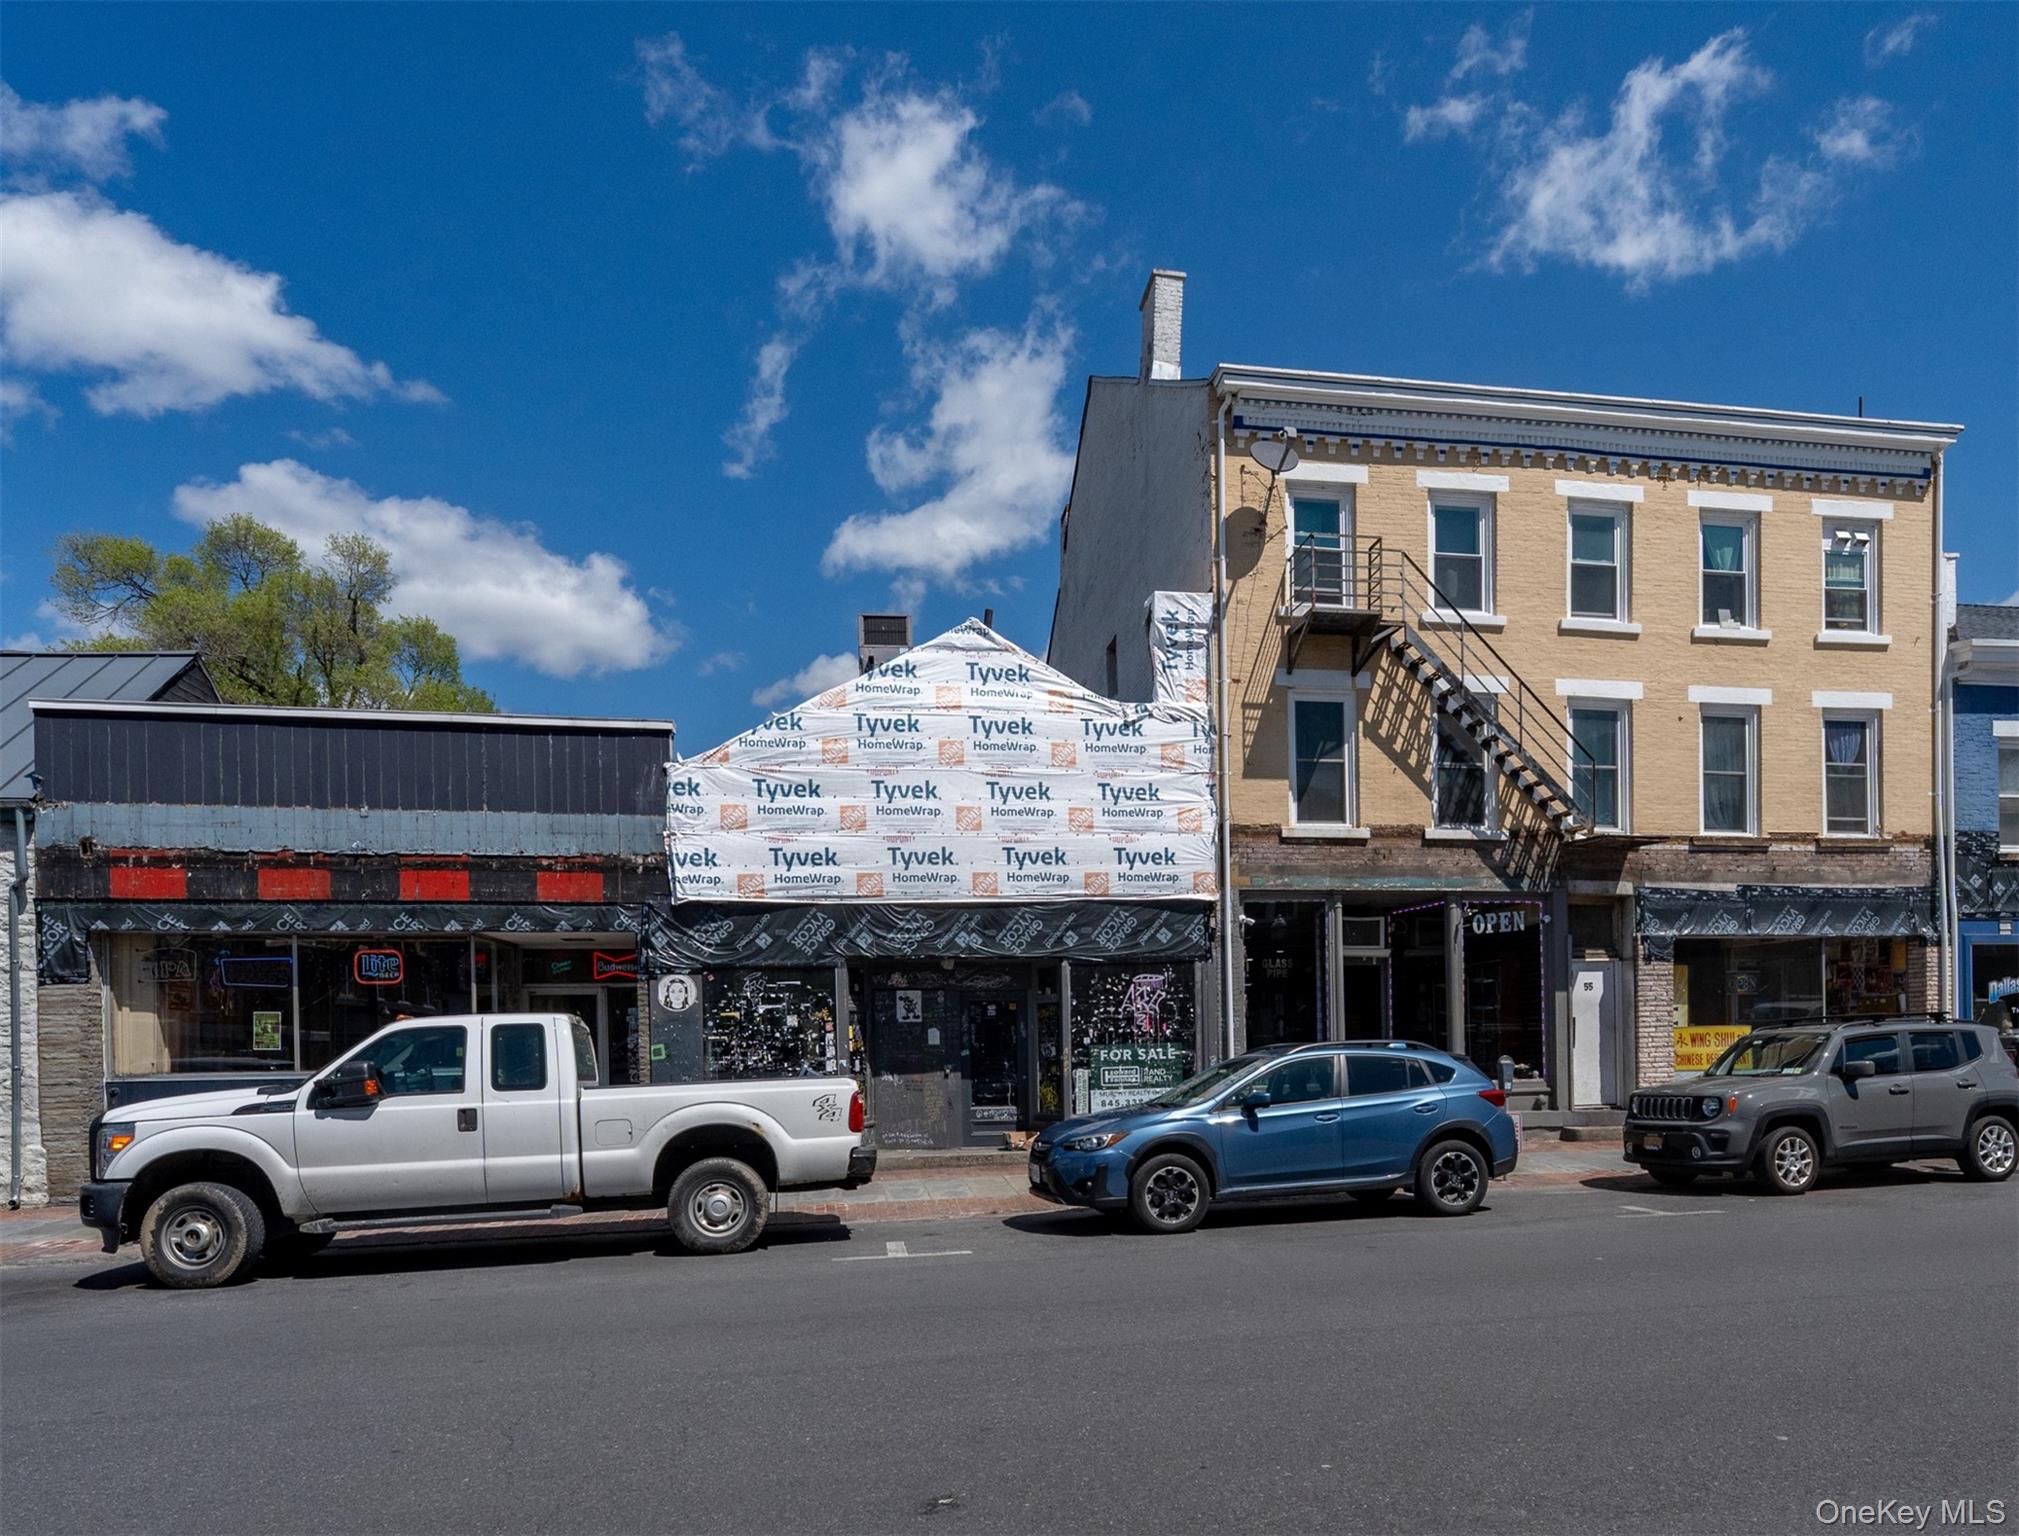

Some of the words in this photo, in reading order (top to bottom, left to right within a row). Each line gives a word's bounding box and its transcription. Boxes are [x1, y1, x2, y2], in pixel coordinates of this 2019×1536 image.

[1162, 609, 1183, 673] Tyvek
[865, 659, 918, 681] yvek
[966, 662, 1030, 685] Tyvek
[853, 713, 920, 737] Tyvek
[968, 715, 1033, 739] Tyvek
[1080, 718, 1143, 741] Tyvek
[752, 778, 821, 803] Tyvek
[871, 780, 937, 803] Tyvek
[986, 781, 1051, 805] Tyvek
[1097, 783, 1160, 806] Tyvek
[769, 847, 837, 872] Tyvek
[887, 847, 955, 871] Tyvek
[1002, 847, 1066, 870] Tyvek
[1113, 847, 1176, 870] Tyvek
[791, 911, 828, 949] VYCOR
[1000, 912, 1036, 949] VYCOR
[1095, 910, 1130, 948] VYCOR
[1105, 916, 1138, 952] GRACE
[1472, 911, 1525, 934] OPEN
[801, 919, 836, 956] GRACE
[1010, 919, 1043, 954] GRACE
[1261, 959, 1294, 968] GLASS
[1583, 982, 1594, 991] 55
[1689, 1032, 1712, 1048] WING
[1100, 1048, 1132, 1061] FOR
[1138, 1047, 1176, 1060] SALE
